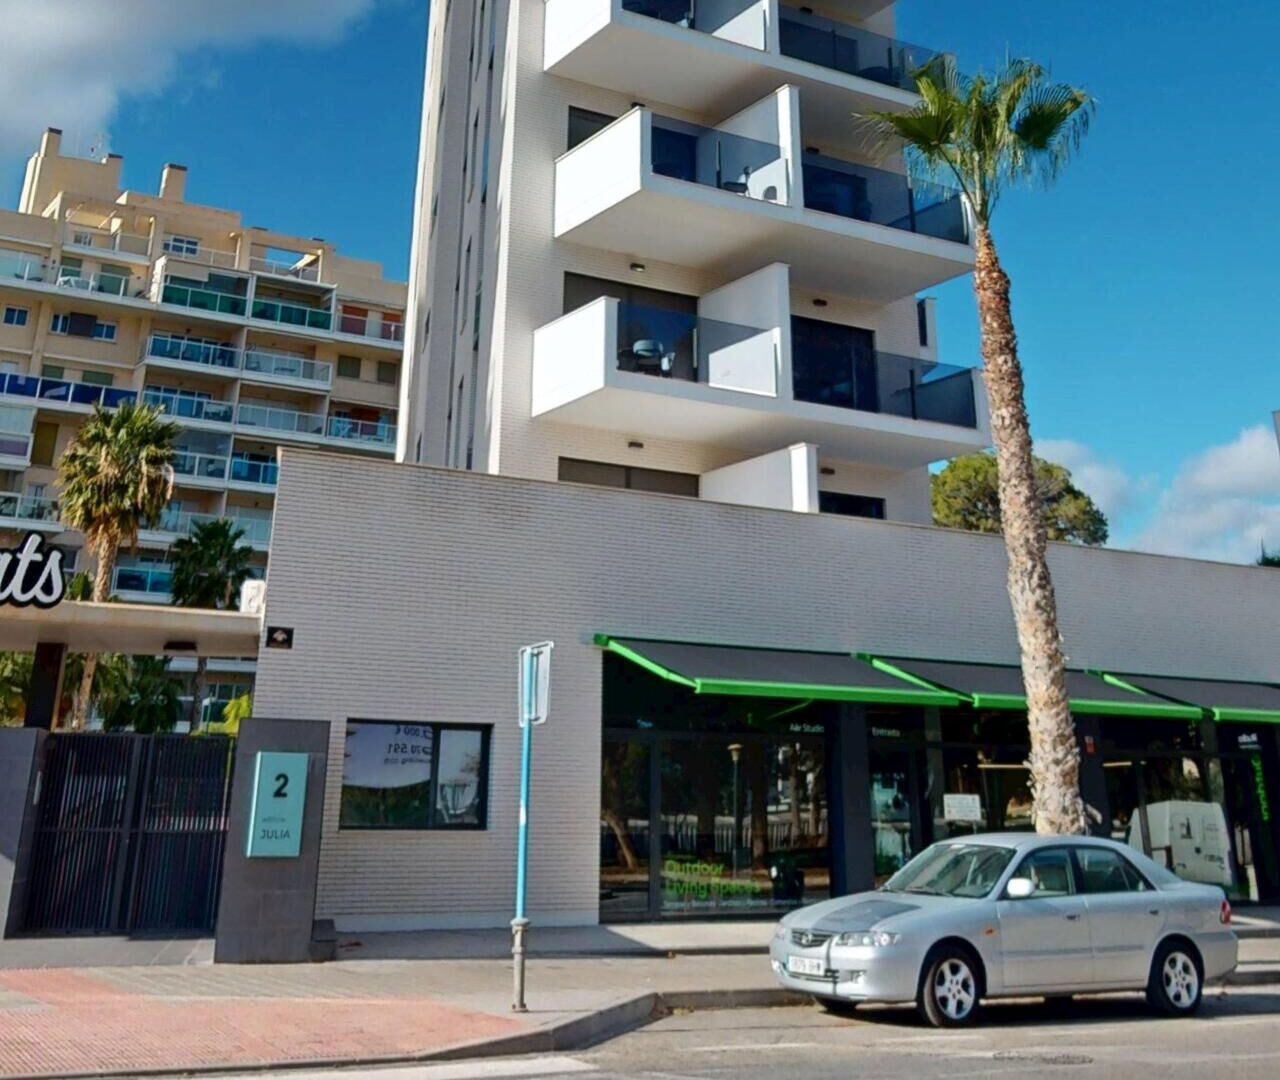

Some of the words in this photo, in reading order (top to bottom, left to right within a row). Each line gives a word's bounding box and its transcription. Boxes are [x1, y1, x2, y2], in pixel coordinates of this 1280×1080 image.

[273, 773, 289, 798] 2
[260, 829, 291, 840] JULIA
[664, 859, 724, 875] Outdoor
[664, 879, 708, 898] Living
